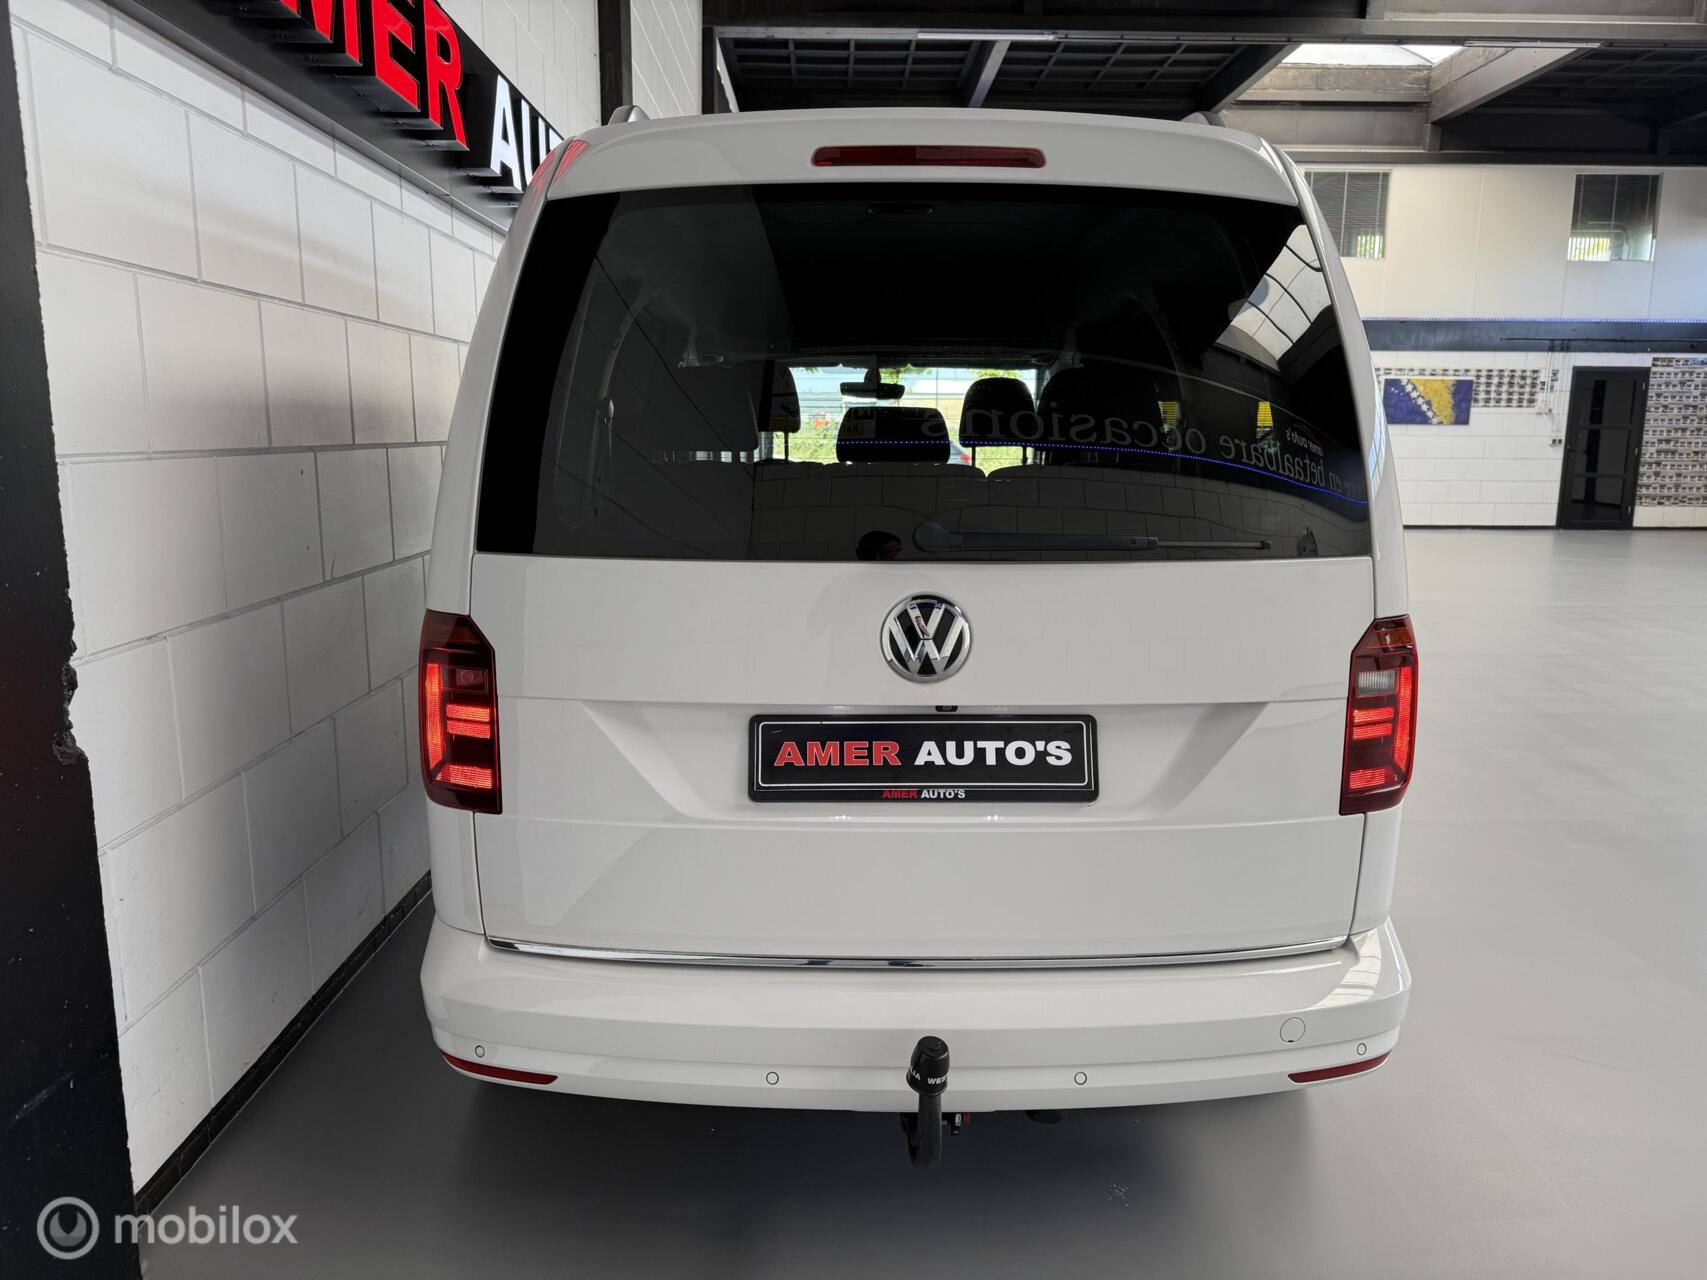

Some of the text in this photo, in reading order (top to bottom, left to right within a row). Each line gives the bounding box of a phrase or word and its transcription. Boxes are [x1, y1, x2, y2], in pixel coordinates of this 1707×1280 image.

[490, 74, 563, 191] AU
[774, 740, 1073, 767] AMER AUTO'S
[882, 788, 966, 799] AMER AUTO'S
